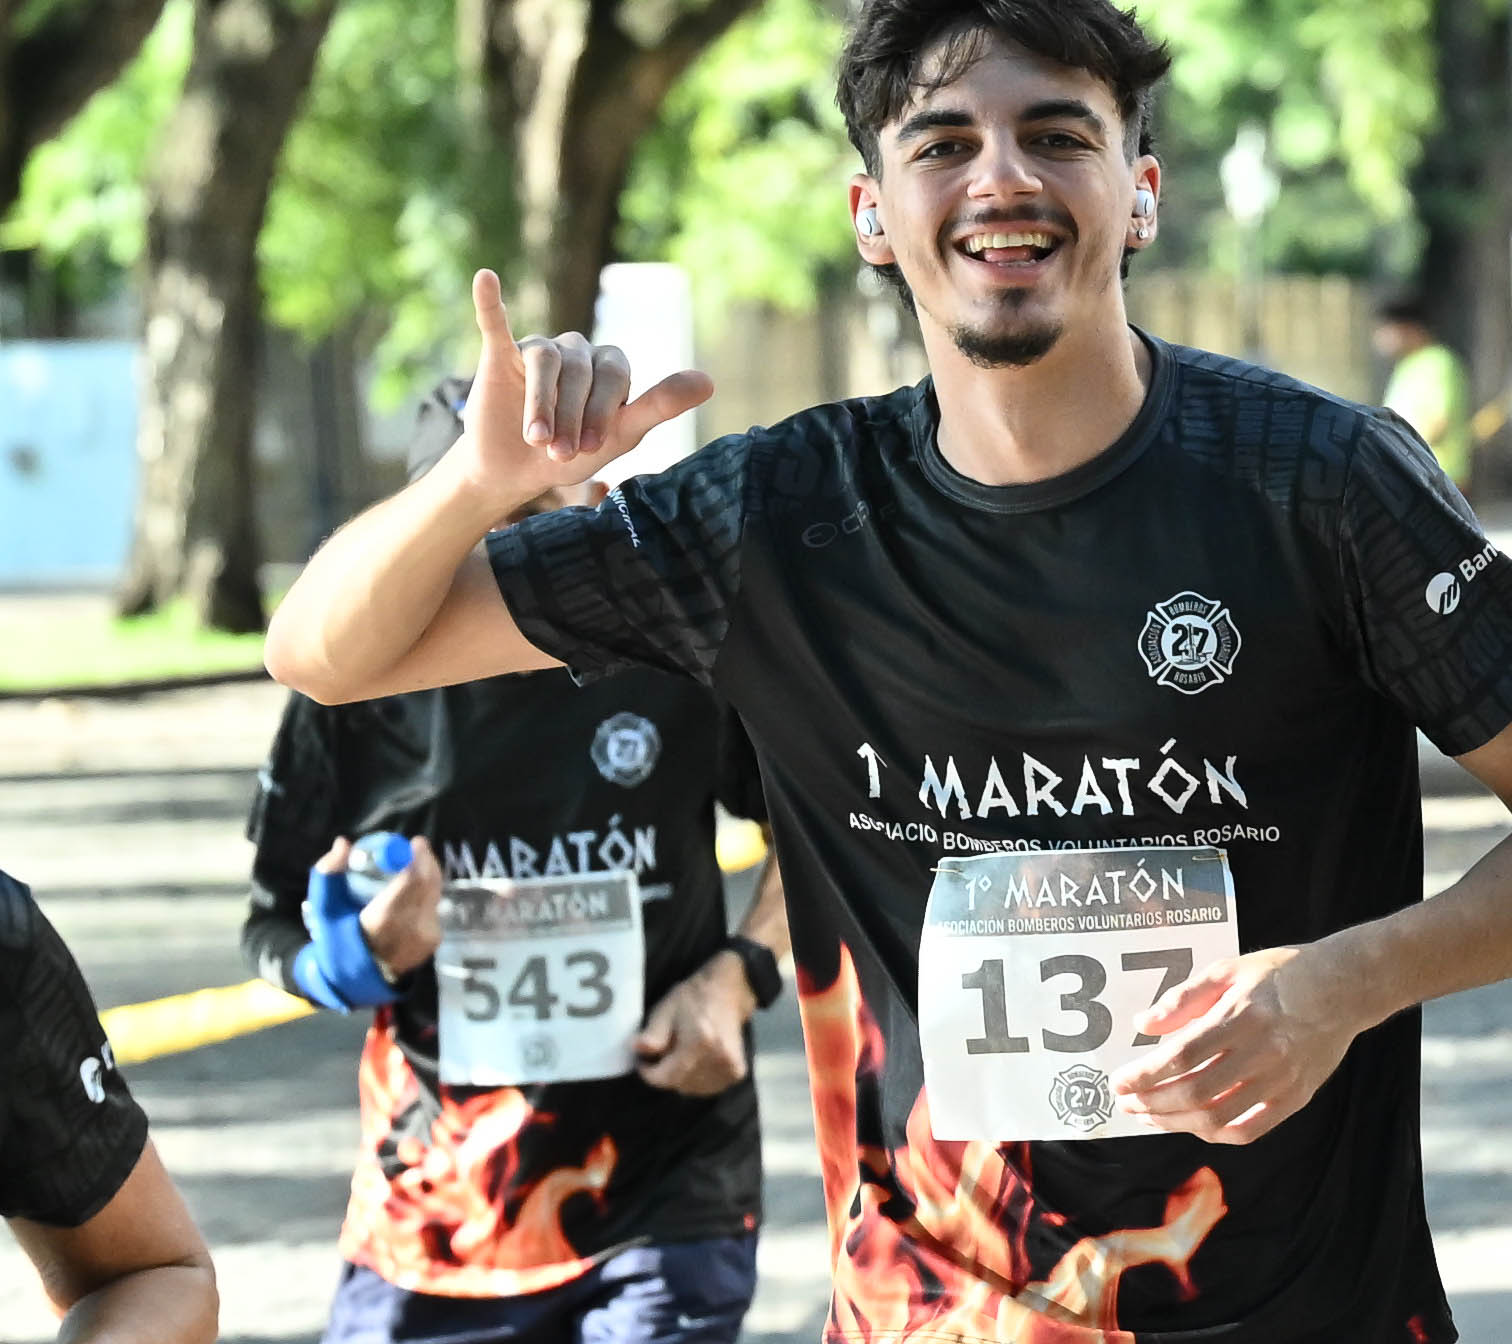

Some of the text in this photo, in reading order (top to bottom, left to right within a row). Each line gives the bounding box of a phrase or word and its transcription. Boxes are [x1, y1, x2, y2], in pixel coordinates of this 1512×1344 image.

[1171, 623, 1209, 657] 27
[918, 738, 1249, 820] MARATÓN
[442, 813, 656, 881] MARATÓN
[943, 831, 1041, 853] BOMBEROS
[1193, 824, 1281, 847] ROSARIO
[1003, 857, 1186, 909] MARATÓN
[1007, 912, 1075, 933] BOMBEROS
[1078, 910, 1163, 930] VOLUNTARIOS
[1166, 906, 1222, 924] ROSARIO
[461, 950, 614, 1023] 543
[961, 947, 1194, 1055] 137
[1070, 1085, 1096, 1108] 27
